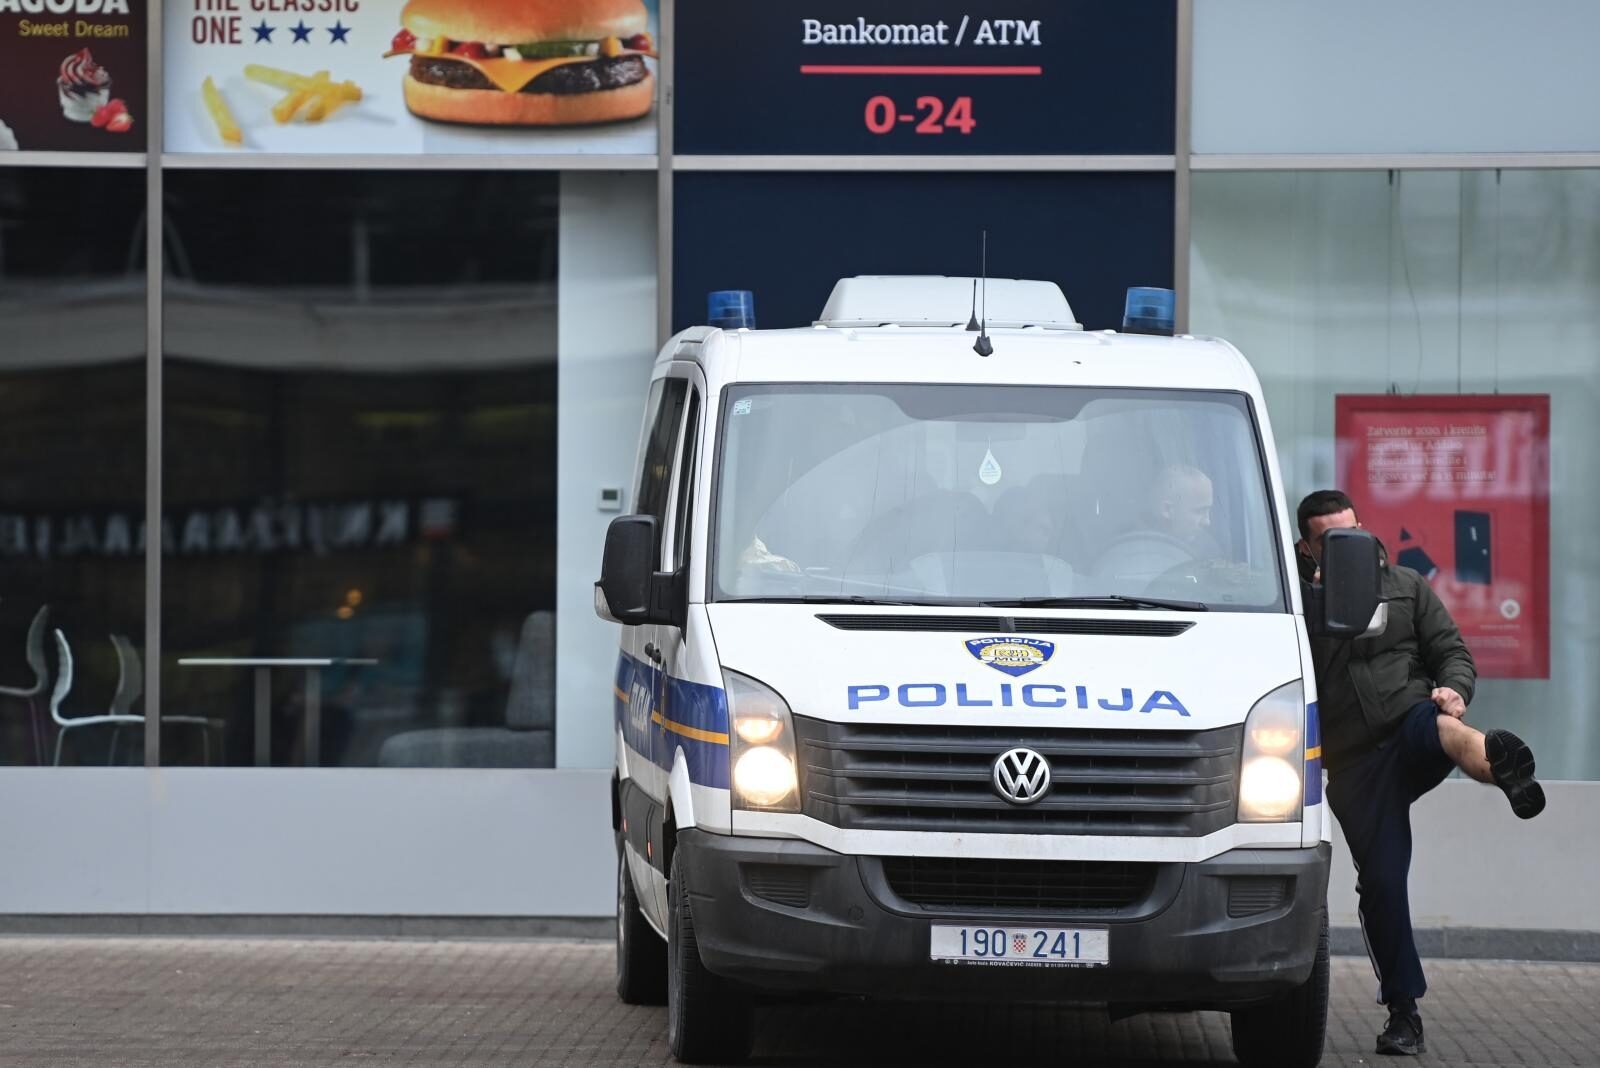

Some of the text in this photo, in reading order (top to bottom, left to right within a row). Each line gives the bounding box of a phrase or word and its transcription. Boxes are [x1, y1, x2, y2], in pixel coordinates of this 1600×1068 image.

[18, 19, 129, 37] Sweet Dream
[192, 16, 242, 44] ONE
[802, 15, 1042, 46] Bankomat / ATM
[864, 95, 976, 134] 0-24
[969, 637, 1051, 648] POLICIJA
[848, 683, 1191, 717] POLICIJA
[960, 928, 1080, 958] 190 241
